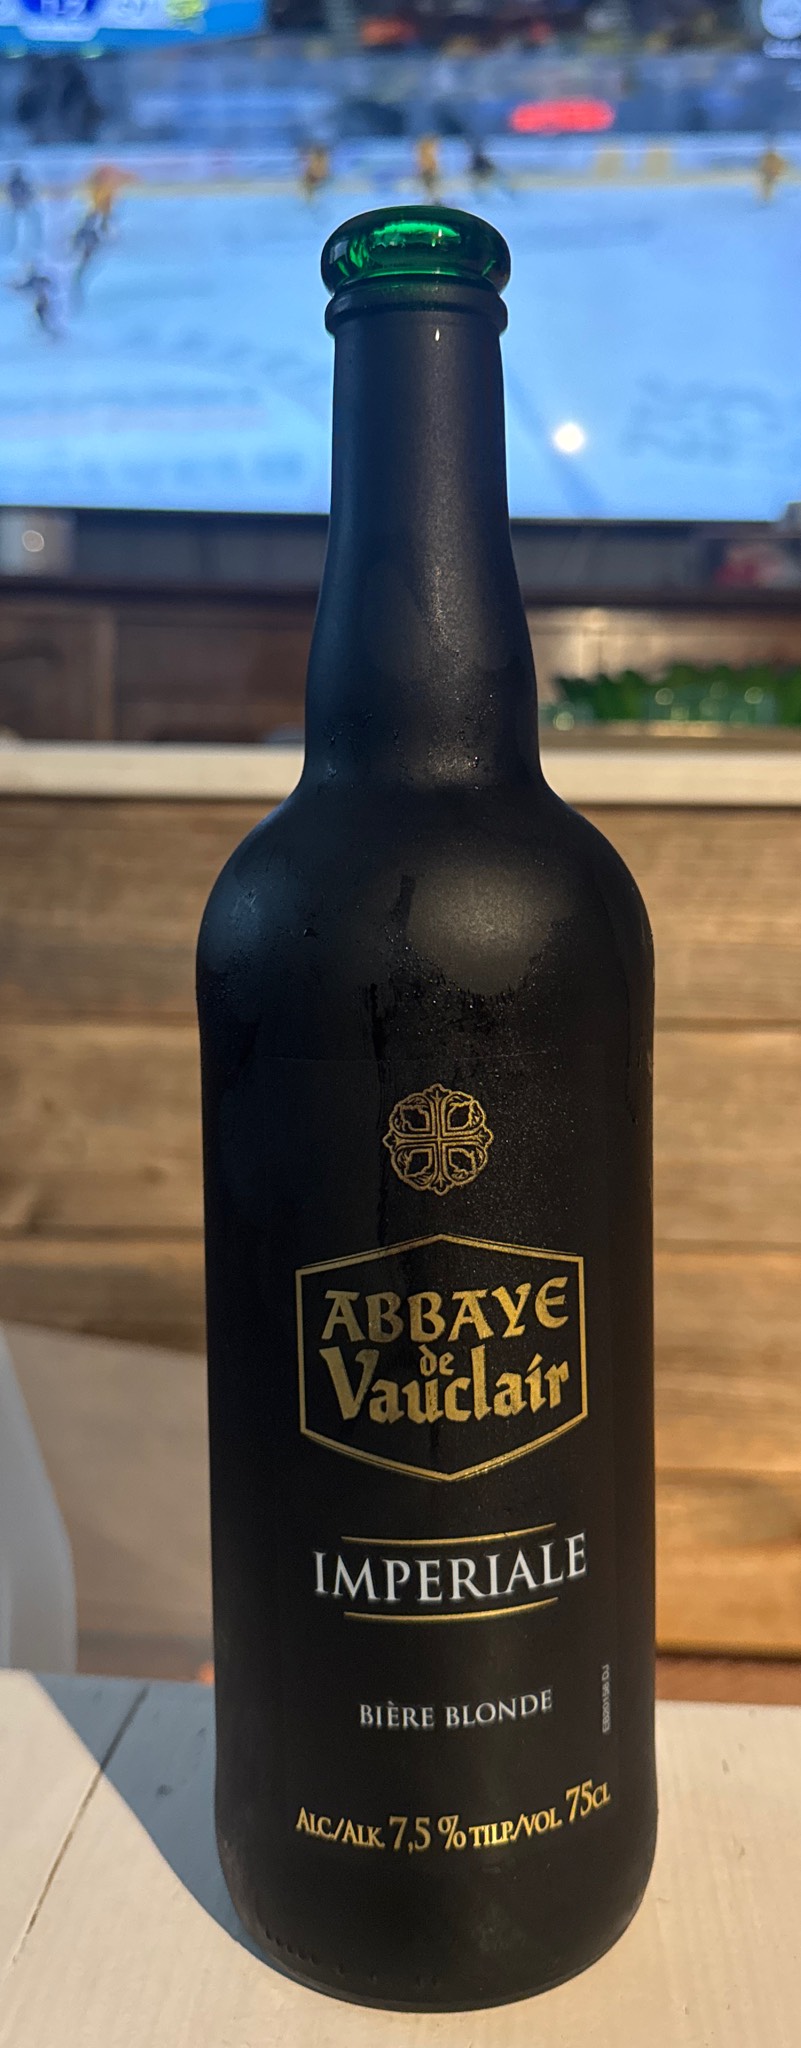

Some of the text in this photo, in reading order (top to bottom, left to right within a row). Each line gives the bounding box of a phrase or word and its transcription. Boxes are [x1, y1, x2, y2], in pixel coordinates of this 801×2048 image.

[321, 1276, 569, 1343] ABBAYE
[319, 1344, 570, 1425] Vauclair
[418, 1344, 455, 1377] de
[313, 1532, 587, 1604] IMPERIALE
[359, 1688, 553, 1729] BIÈRE BLONDE
